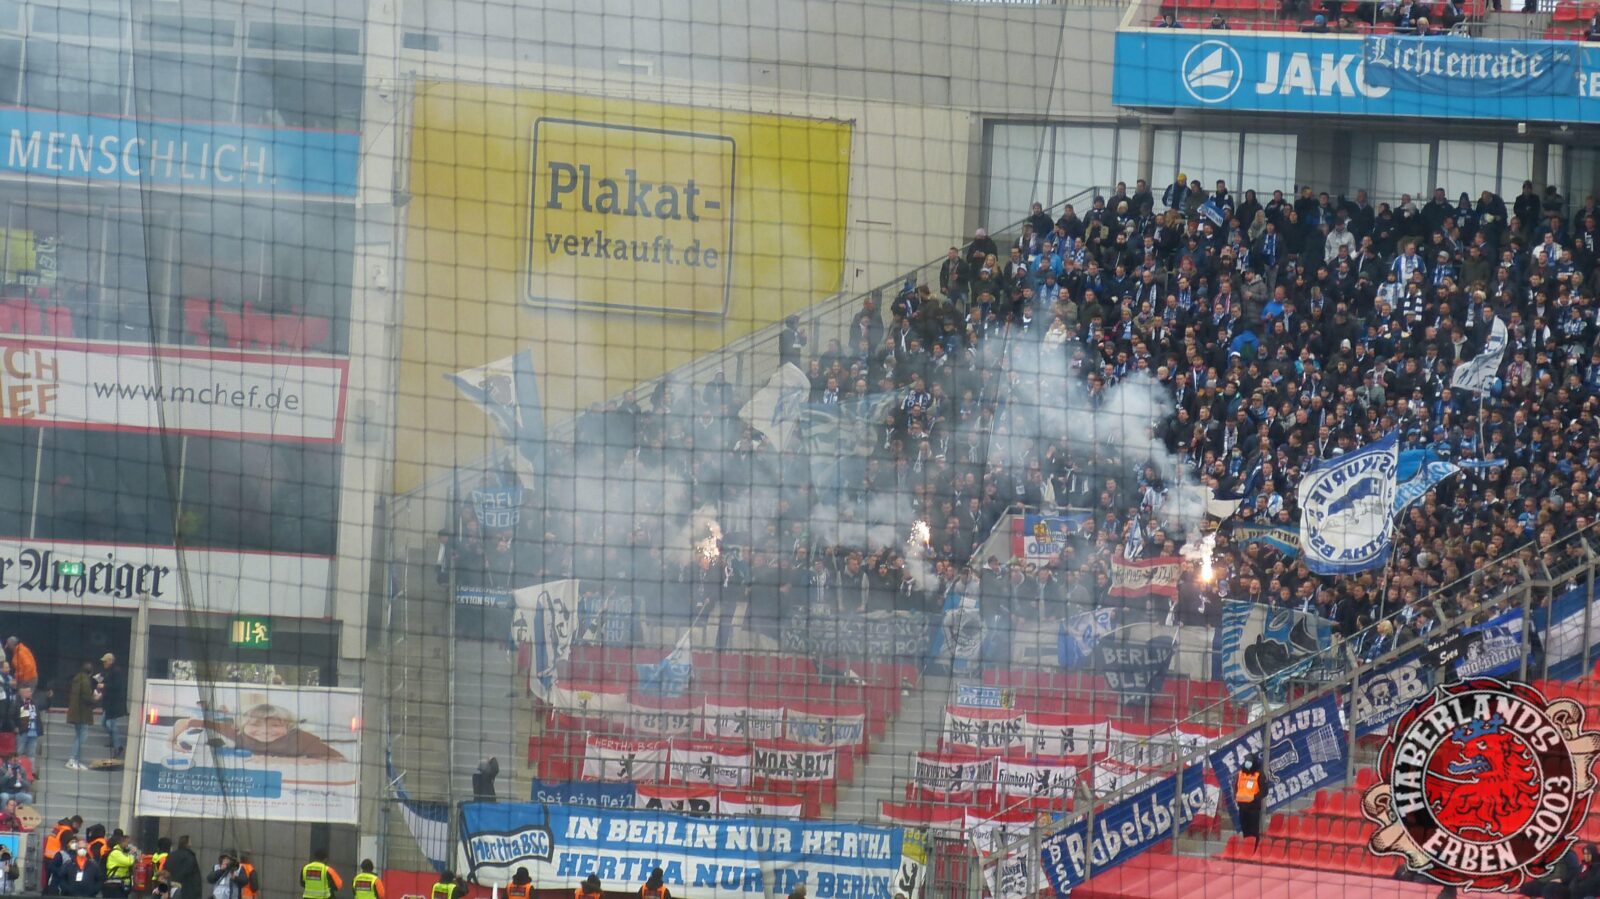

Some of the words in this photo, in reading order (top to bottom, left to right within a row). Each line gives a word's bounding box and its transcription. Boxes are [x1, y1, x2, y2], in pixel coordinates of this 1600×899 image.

[1369, 36, 1544, 80] Lichtenrade
[8, 128, 277, 185] MENSCHLICH.
[546, 161, 721, 222] Plakat-
[545, 230, 719, 268] verkauft.de
[94, 381, 300, 410] www.mchef.de
[18, 549, 170, 598] Anzeiger
[1222, 730, 1264, 773] FAN
[1270, 706, 1326, 741] CLUB
[537, 790, 562, 807] Sei
[569, 793, 597, 806] ein
[600, 794, 633, 809] Teil
[565, 816, 603, 841] IN
[606, 819, 720, 849] BERLIN
[726, 825, 792, 854] NUR
[800, 828, 892, 860] HERTHA
[556, 852, 685, 886] HERTHA
[693, 863, 765, 894] NUR
[773, 868, 809, 895] IN
[816, 871, 891, 899] BERLIN
